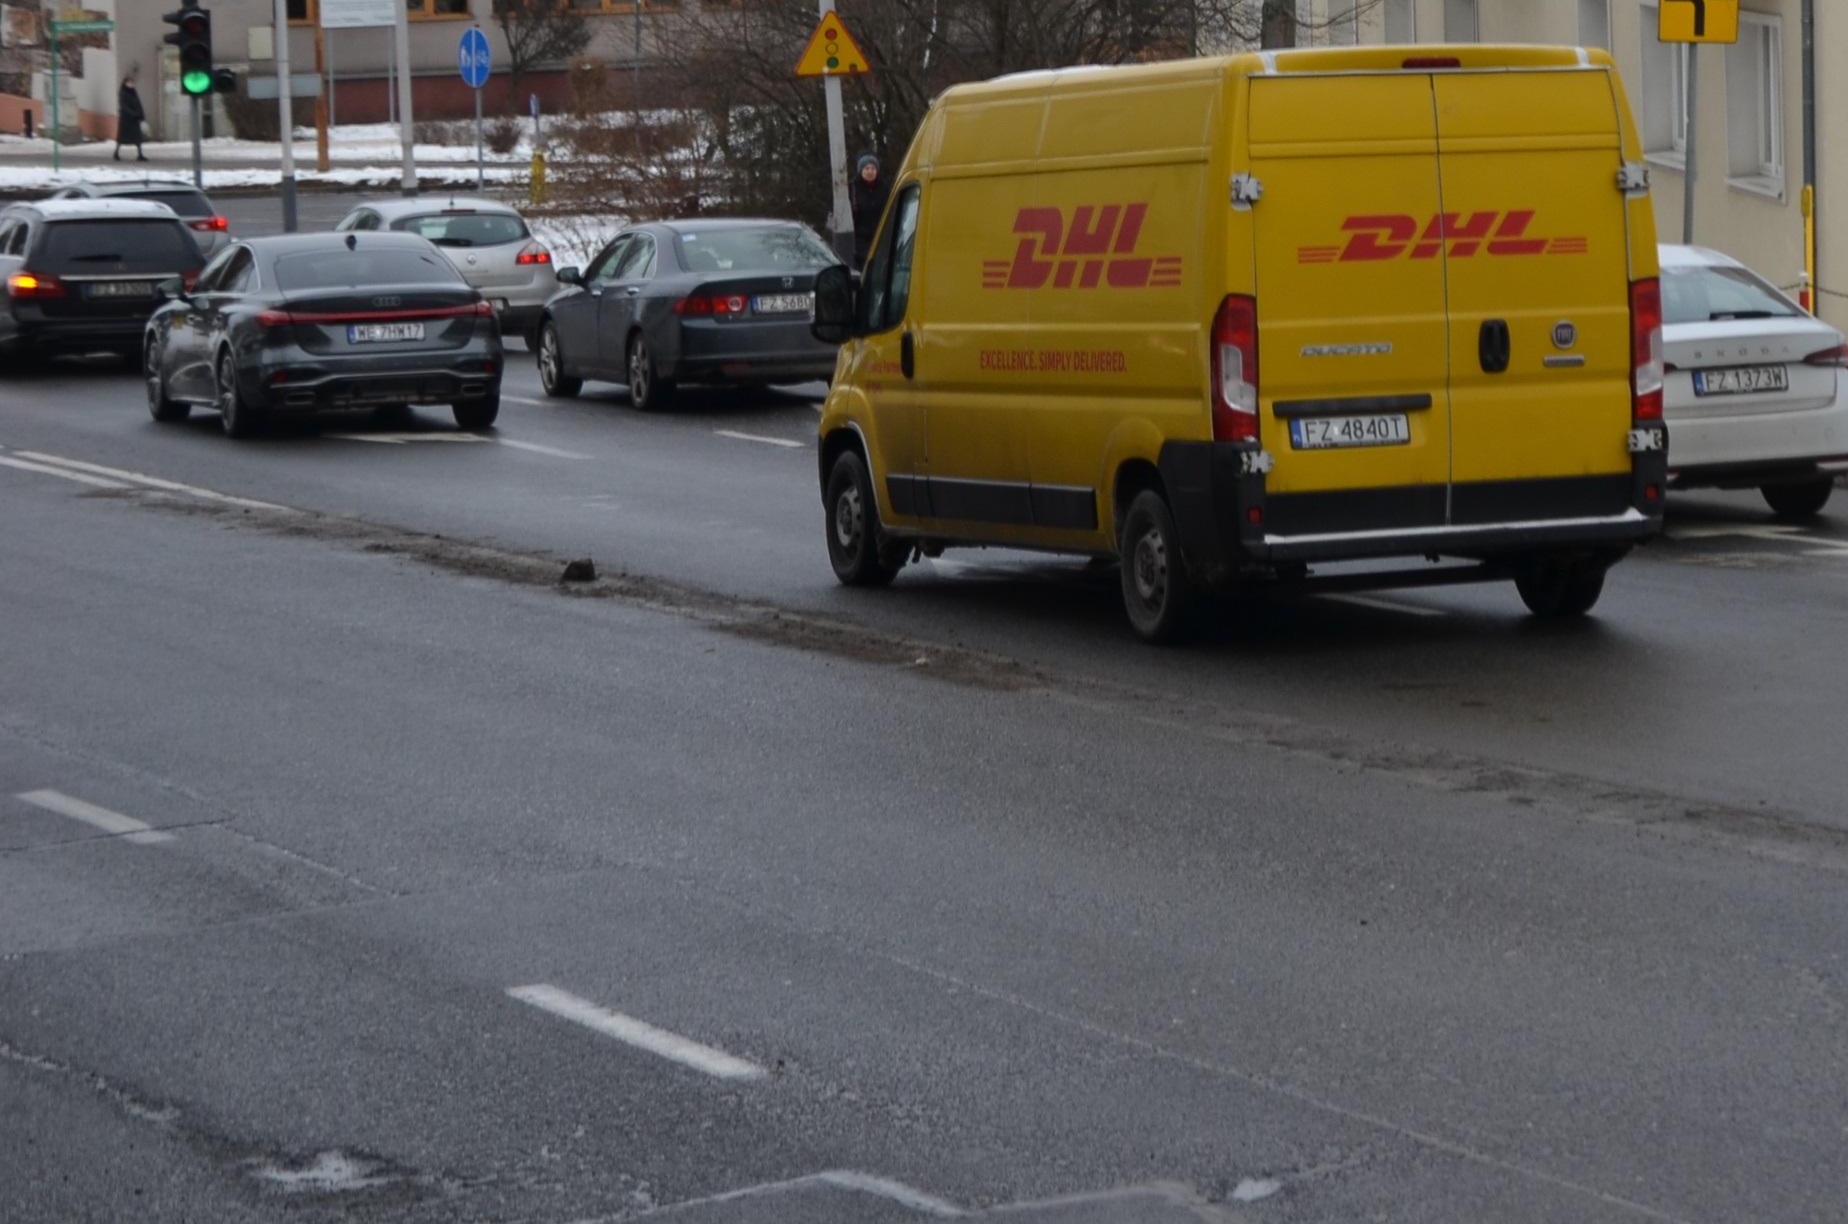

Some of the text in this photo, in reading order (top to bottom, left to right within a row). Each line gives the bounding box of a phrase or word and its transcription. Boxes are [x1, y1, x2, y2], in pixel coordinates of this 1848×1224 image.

[1007, 204, 1153, 289] DHL
[1338, 210, 1549, 262] DHL
[980, 350, 1127, 373] EXCELLENCE. SIMPLY DELIVERED.
[1705, 367, 1783, 391] FZ 1373W
[1305, 417, 1401, 443] FZ 4840T
